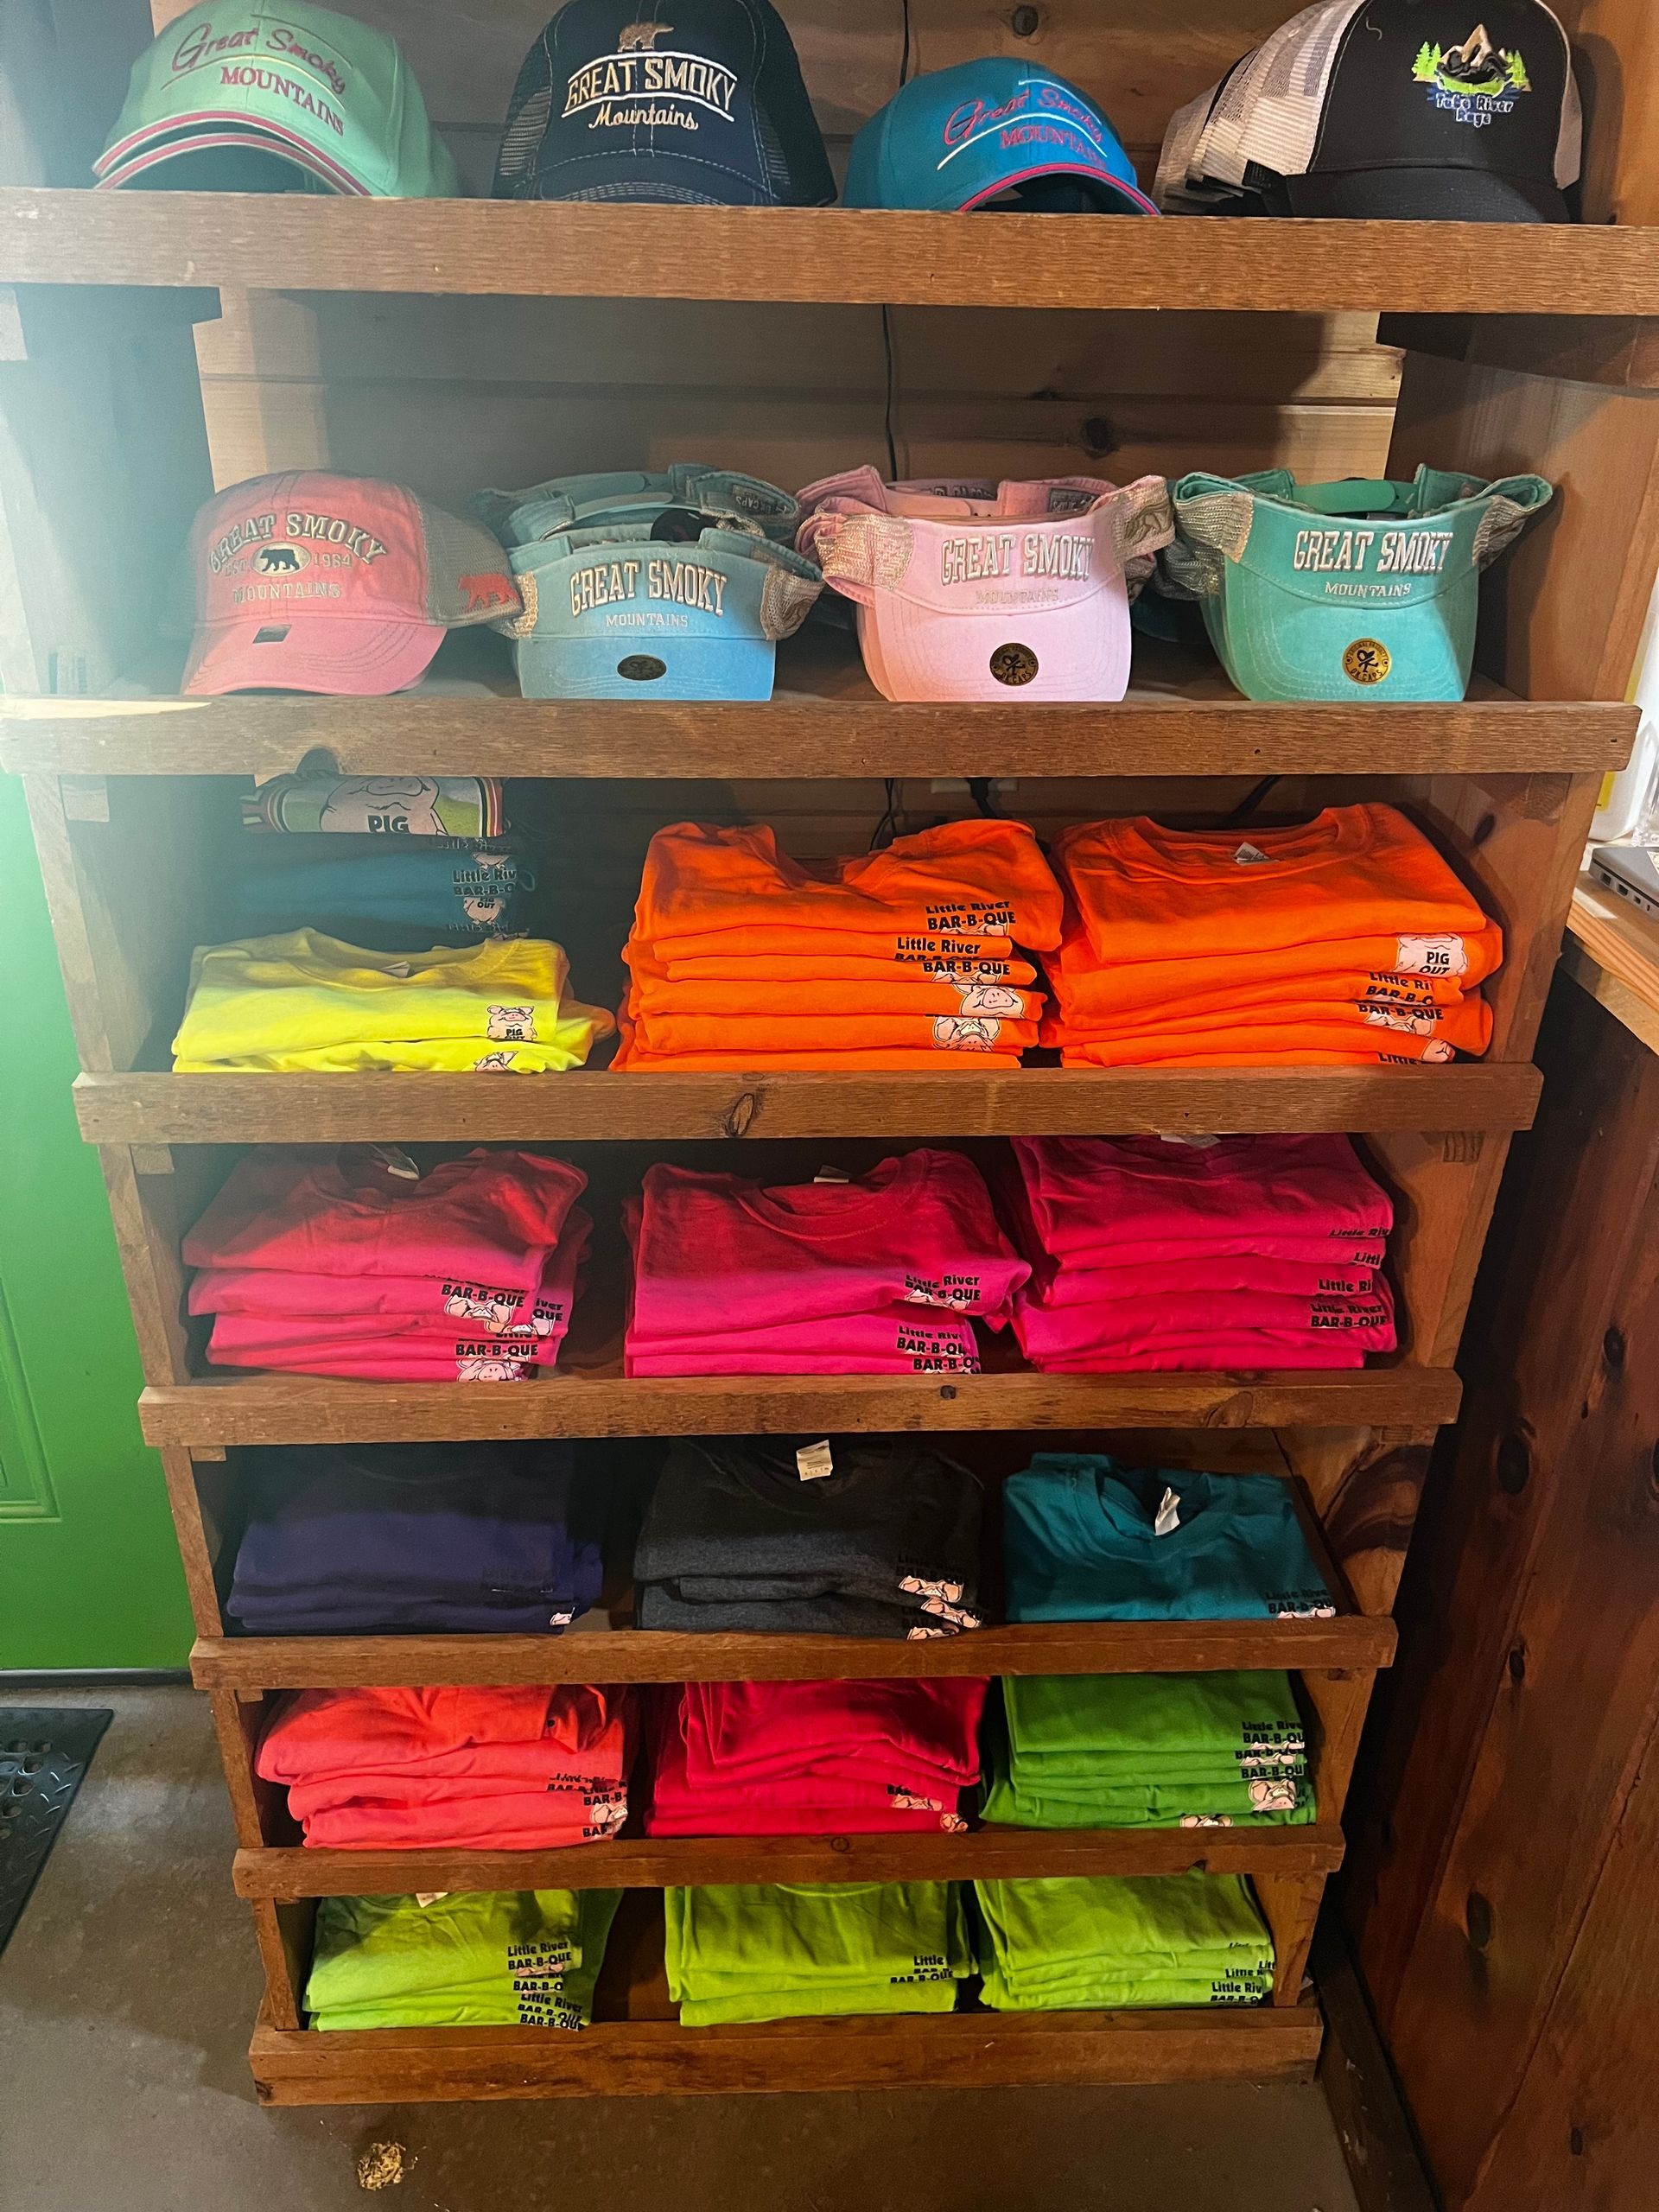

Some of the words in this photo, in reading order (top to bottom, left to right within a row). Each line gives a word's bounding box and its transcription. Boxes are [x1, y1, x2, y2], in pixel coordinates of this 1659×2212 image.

[172, 22, 259, 73] Great
[266, 29, 346, 95] Smoky
[565, 60, 637, 111] GREAT
[645, 58, 736, 111] SMOKY
[220, 67, 344, 137] MOUNTAINS
[588, 101, 699, 130] Mountains
[943, 89, 1031, 146] Great
[208, 513, 276, 574] GREAT
[286, 512, 389, 565] SMOKY
[940, 533, 1017, 587] GREAT
[1023, 532, 1096, 582] SMOKY
[1293, 529, 1374, 573] GREAT
[1376, 531, 1453, 574] SMOKY
[232, 581, 342, 604] MOUNTAINS
[569, 560, 642, 618] GREAT
[648, 559, 728, 617] SMOKY
[1324, 581, 1413, 598] MOUNTAINS
[605, 612, 690, 629] MOUNTAINS
[367, 814, 410, 833] PIG
[452, 869, 490, 883] Little
[493, 868, 517, 881] Riv
[453, 881, 516, 897] BAR-B-Q
[925, 903, 967, 914] Little
[970, 901, 1010, 912] River
[927, 912, 1016, 931] BAR-B-QUE
[897, 937, 937, 951] Little
[941, 939, 981, 955] River
[1426, 950, 1450, 965] PIG
[923, 961, 1011, 976] BAR-B-QUE
[1419, 965, 1451, 975] OUT
[1369, 971, 1409, 987] Little
[1365, 985, 1433, 1005] BAR-B-Q
[1358, 1004, 1444, 1020] BAR-B-QUE
[505, 1027, 524, 1037] PIG
[1368, 1227, 1389, 1236] Riv
[1353, 1251, 1382, 1266] Littl
[943, 1274, 980, 1287] River
[1319, 1279, 1354, 1293] Little
[442, 1284, 526, 1307] BAR-B-QUE
[535, 1298, 563, 1311] iver
[899, 1325, 934, 1338] Little
[938, 1332, 962, 1340] Riv
[455, 1344, 538, 1357] BAR-B-QUE
[897, 1337, 966, 1356] BAR-B-Q
[913, 1357, 975, 1371] BAR-B-Q
[1243, 1732, 1304, 1745] BAR-B-QU
[1241, 1764, 1303, 1779] BAR-B-QU
[583, 1791, 627, 1806] BAR-B-
[507, 1944, 537, 1957] Little
[540, 1941, 569, 1954] River
[507, 1952, 572, 1971] BAR-B-QUE
[913, 1955, 944, 1967] Little
[1259, 1960, 1275, 1970] Litt
[513, 1980, 563, 1992] BAR-B-Q
[1211, 1981, 1242, 1993] Little
[1244, 1981, 1262, 1993] Riv
[520, 1993, 552, 2005] Little
[555, 1996, 583, 2013] River
